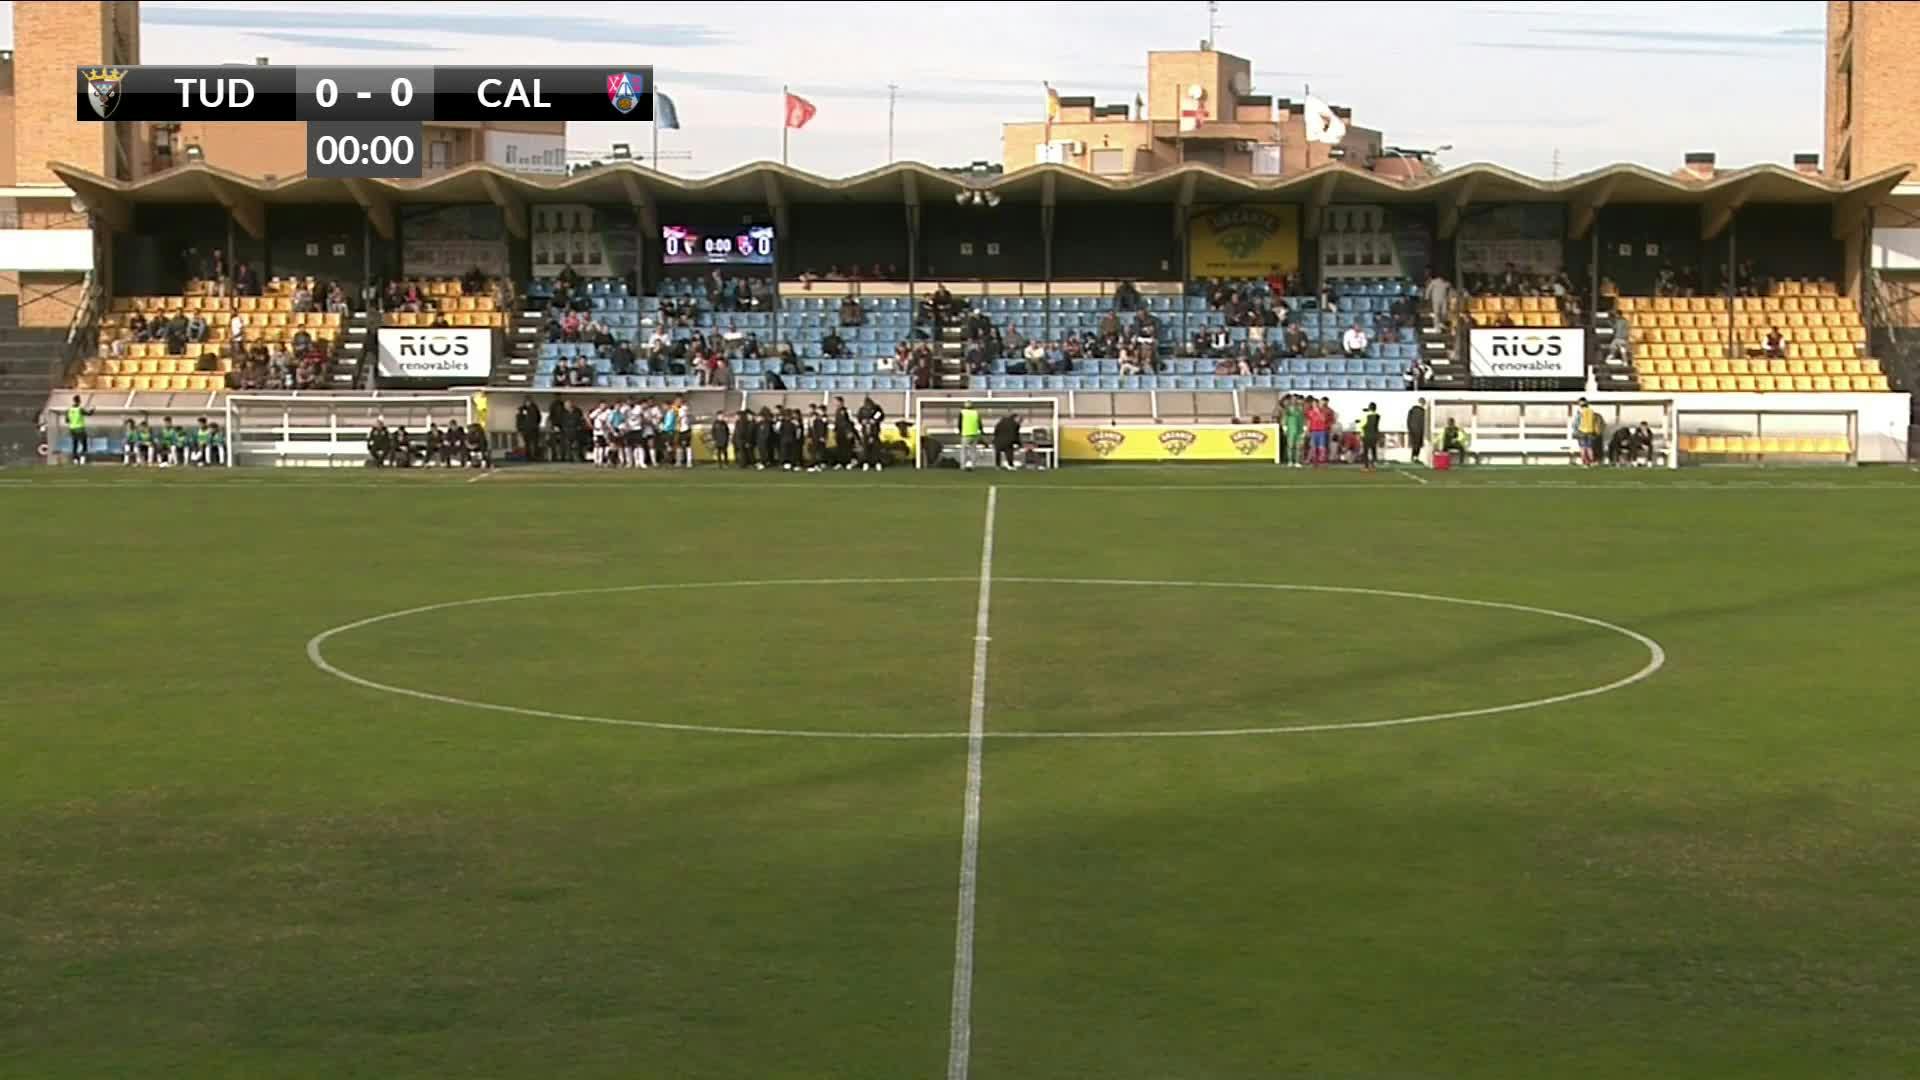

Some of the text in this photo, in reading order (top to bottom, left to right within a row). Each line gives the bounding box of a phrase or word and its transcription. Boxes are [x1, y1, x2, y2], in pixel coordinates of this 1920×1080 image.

[666, 237, 678, 255] 0
[705, 238, 731, 252] 0:00
[758, 237, 770, 255] 0
[399, 360, 469, 371] renovables
[1491, 360, 1561, 371] renovables
